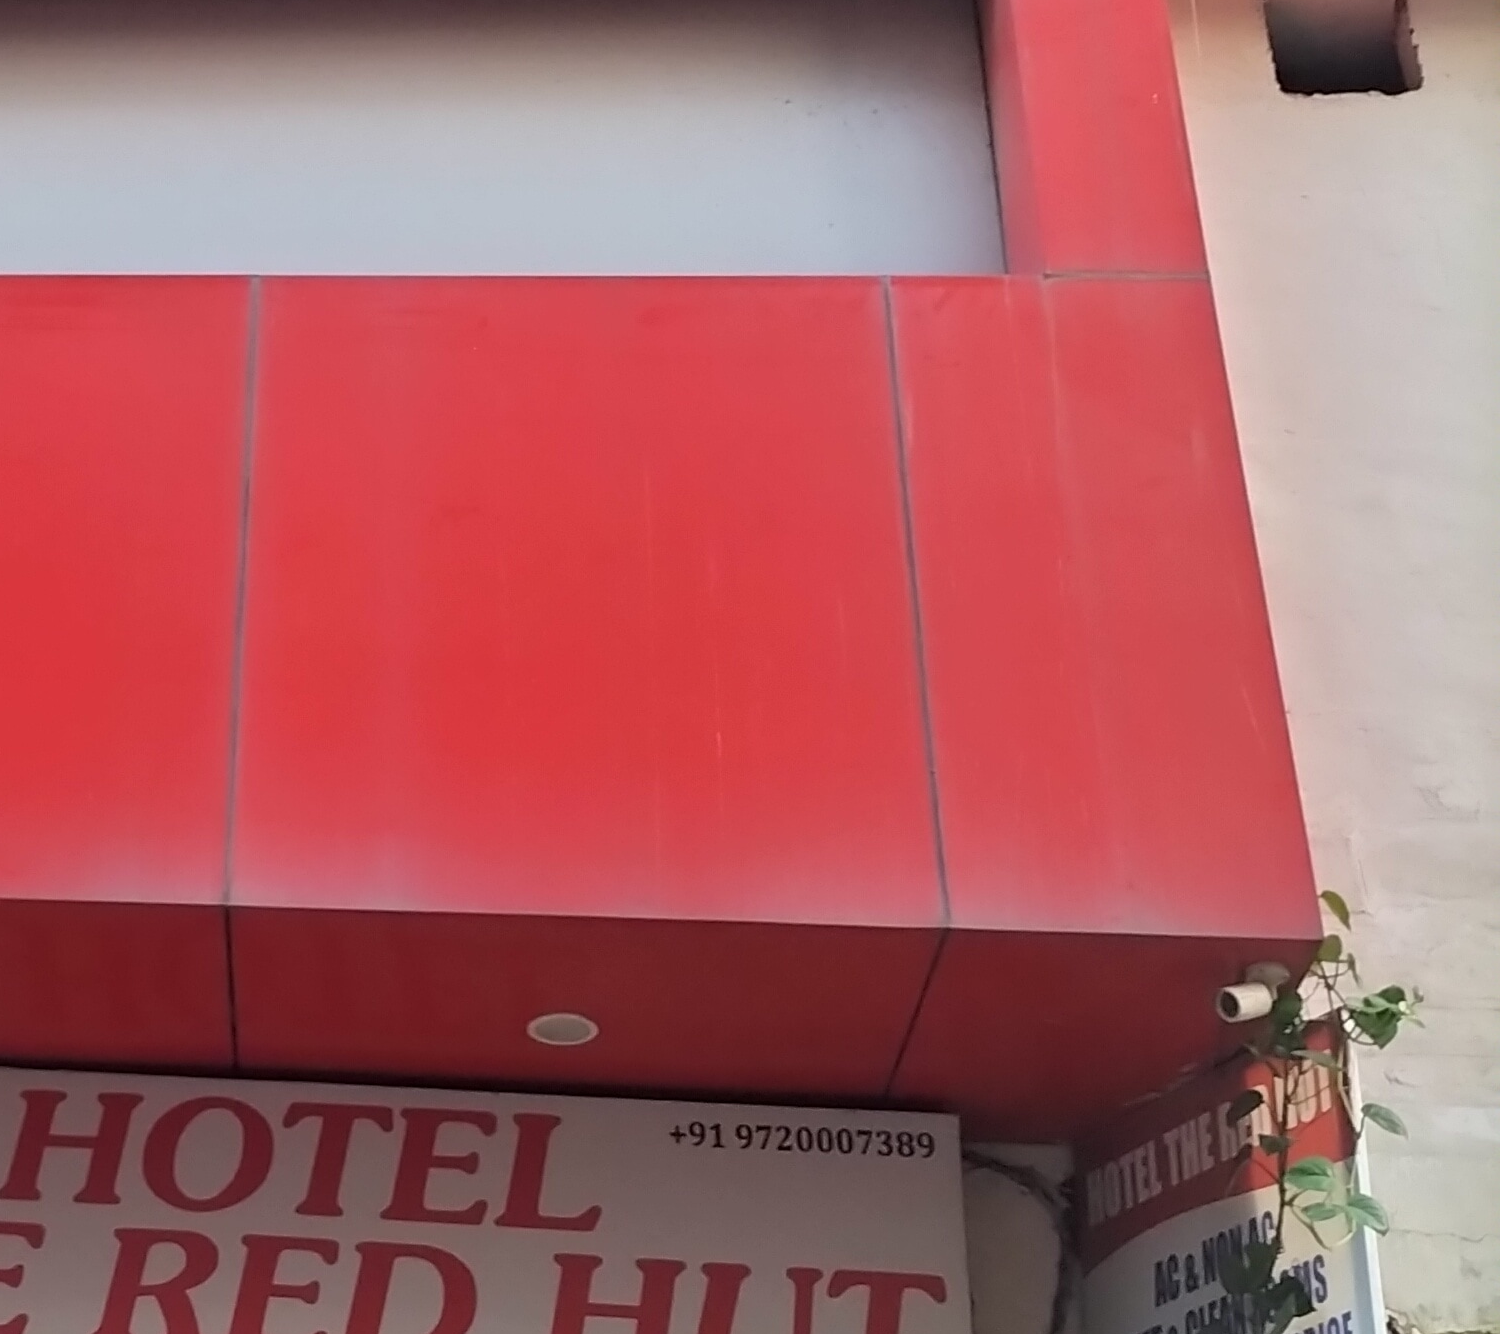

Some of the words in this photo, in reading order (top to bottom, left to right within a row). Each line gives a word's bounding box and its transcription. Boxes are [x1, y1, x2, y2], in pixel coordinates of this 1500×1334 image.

[669, 1122, 726, 1149] +91
[736, 1124, 937, 1158] 9720007389
[1087, 1141, 1164, 1226] HOTEL
[1163, 1111, 1216, 1187] THE
[1153, 1253, 1181, 1308] AC
[1184, 1253, 1199, 1294] &
